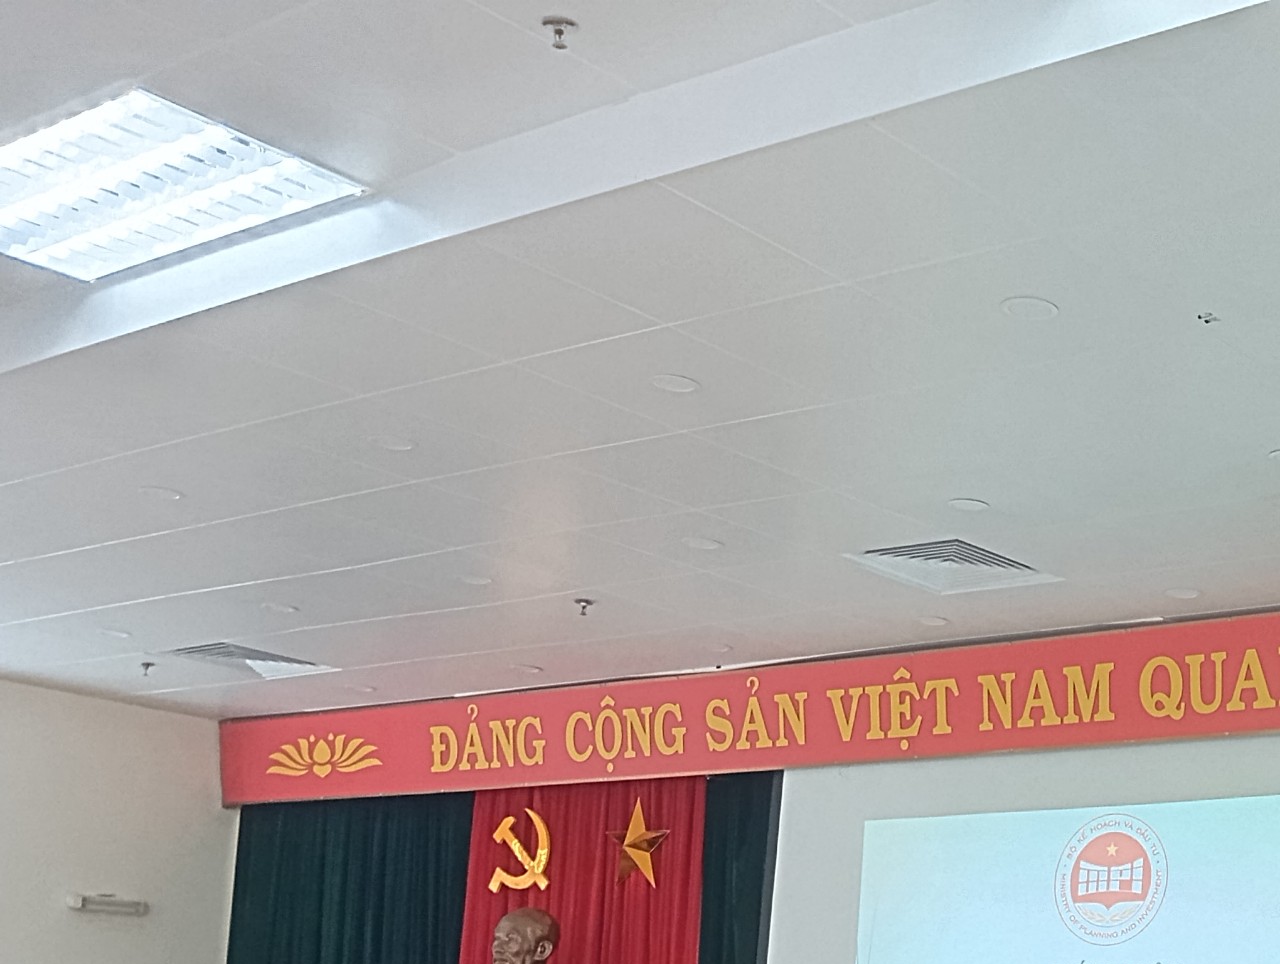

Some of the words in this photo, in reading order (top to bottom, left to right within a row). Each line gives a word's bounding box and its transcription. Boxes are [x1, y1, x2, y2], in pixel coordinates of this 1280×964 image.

[430, 705, 546, 774] ĐẢNG
[565, 696, 687, 774] CỘNG
[705, 676, 808, 752] SẢN
[827, 666, 960, 751] VIỆT
[978, 662, 1116, 732] NAM
[1120, 923, 1137, 936] AND
